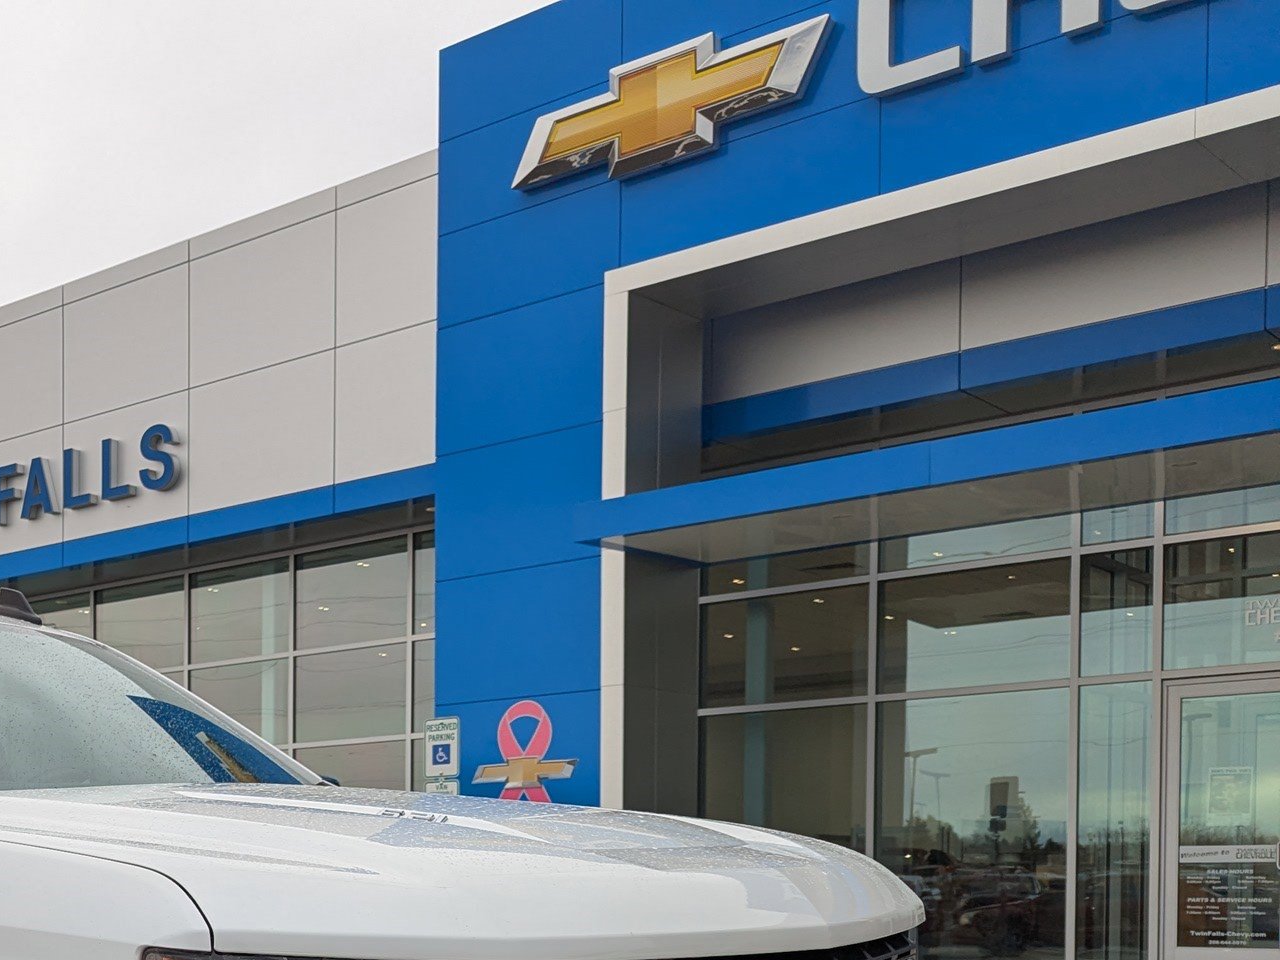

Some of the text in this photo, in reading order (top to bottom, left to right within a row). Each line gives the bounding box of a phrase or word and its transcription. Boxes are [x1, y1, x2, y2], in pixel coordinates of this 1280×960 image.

[427, 722, 457, 732] RESERVED
[428, 732, 455, 742] PARKING
[1190, 930, 1267, 938] TwinFalls-Chevy.com
